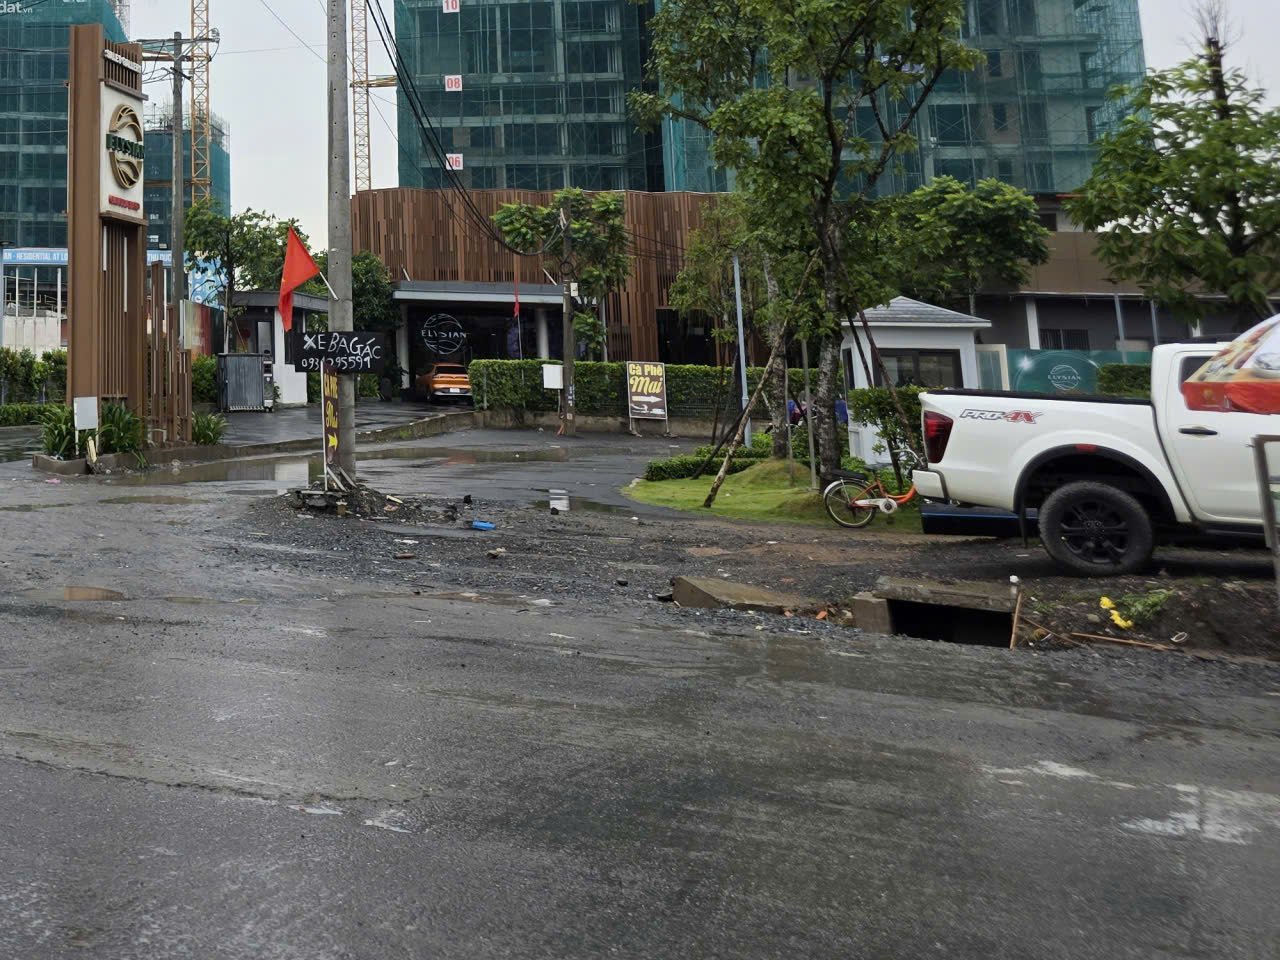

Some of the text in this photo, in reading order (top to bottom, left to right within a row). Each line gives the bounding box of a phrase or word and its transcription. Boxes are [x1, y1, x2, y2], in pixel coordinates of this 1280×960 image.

[445, 0, 458, 11] 10
[447, 78, 461, 89] 08
[448, 156, 461, 168] 06
[303, 333, 326, 350] XE
[629, 363, 663, 376] Cà Phê
[630, 376, 663, 394] Mai
